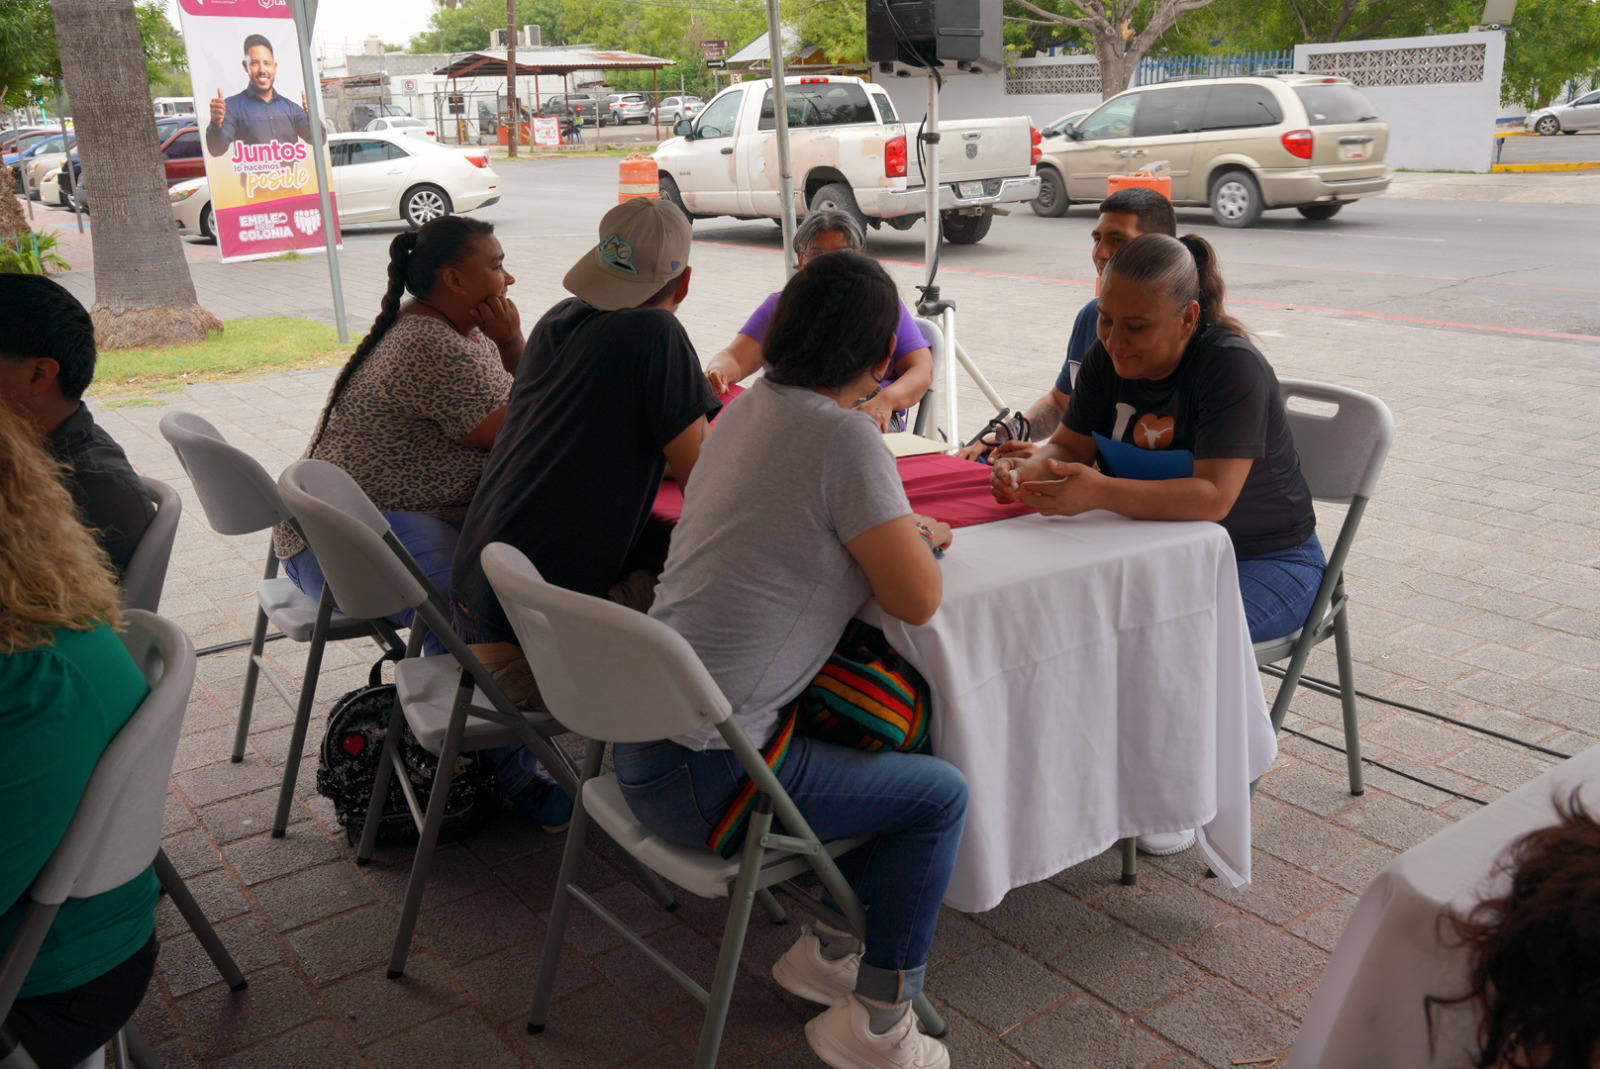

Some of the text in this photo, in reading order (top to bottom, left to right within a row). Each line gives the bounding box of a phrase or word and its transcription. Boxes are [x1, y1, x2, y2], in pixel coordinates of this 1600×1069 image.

[231, 141, 306, 163] Juntos
[233, 163, 280, 172] lo hacemos
[247, 162, 310, 198] posible
[239, 212, 288, 227] EMPLEO
[239, 226, 294, 242] COLONIA
